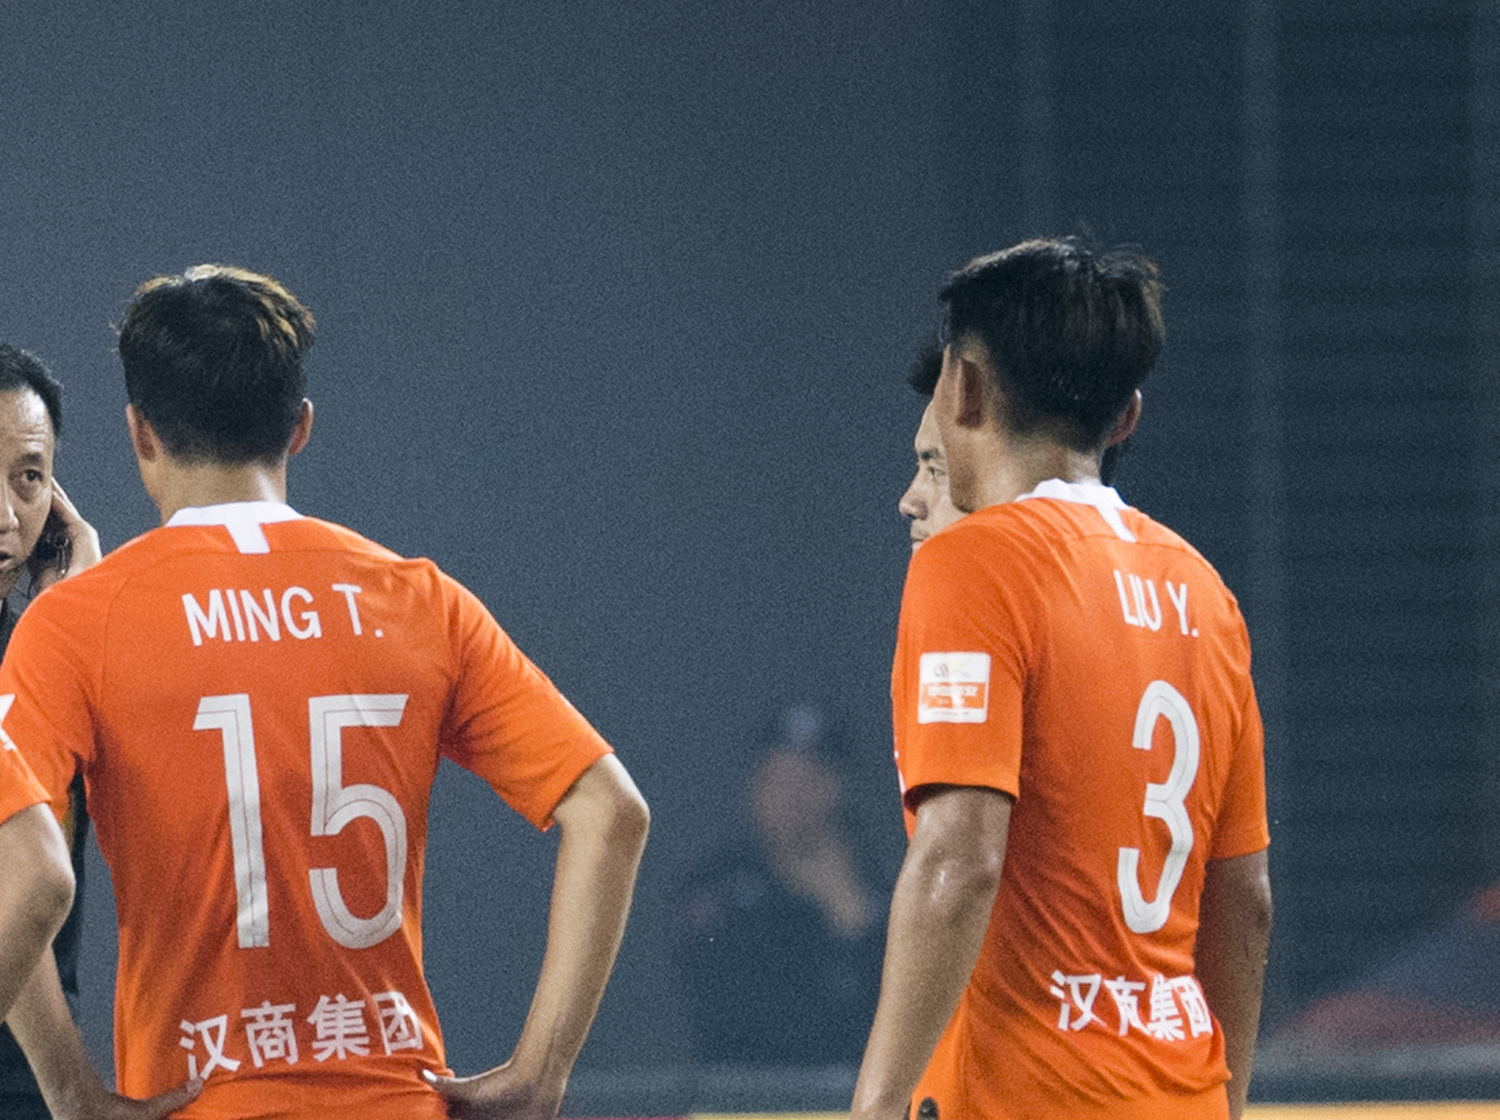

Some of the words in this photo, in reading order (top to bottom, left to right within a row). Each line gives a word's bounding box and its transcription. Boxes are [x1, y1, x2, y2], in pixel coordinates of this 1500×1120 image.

[182, 585, 322, 646] MING
[332, 582, 384, 638] T.
[1113, 569, 1162, 632] LIU
[1165, 579, 1199, 638] Y.
[192, 693, 409, 950] 15
[1117, 680, 1200, 933] 3
[179, 990, 424, 1080] 汉商集团
